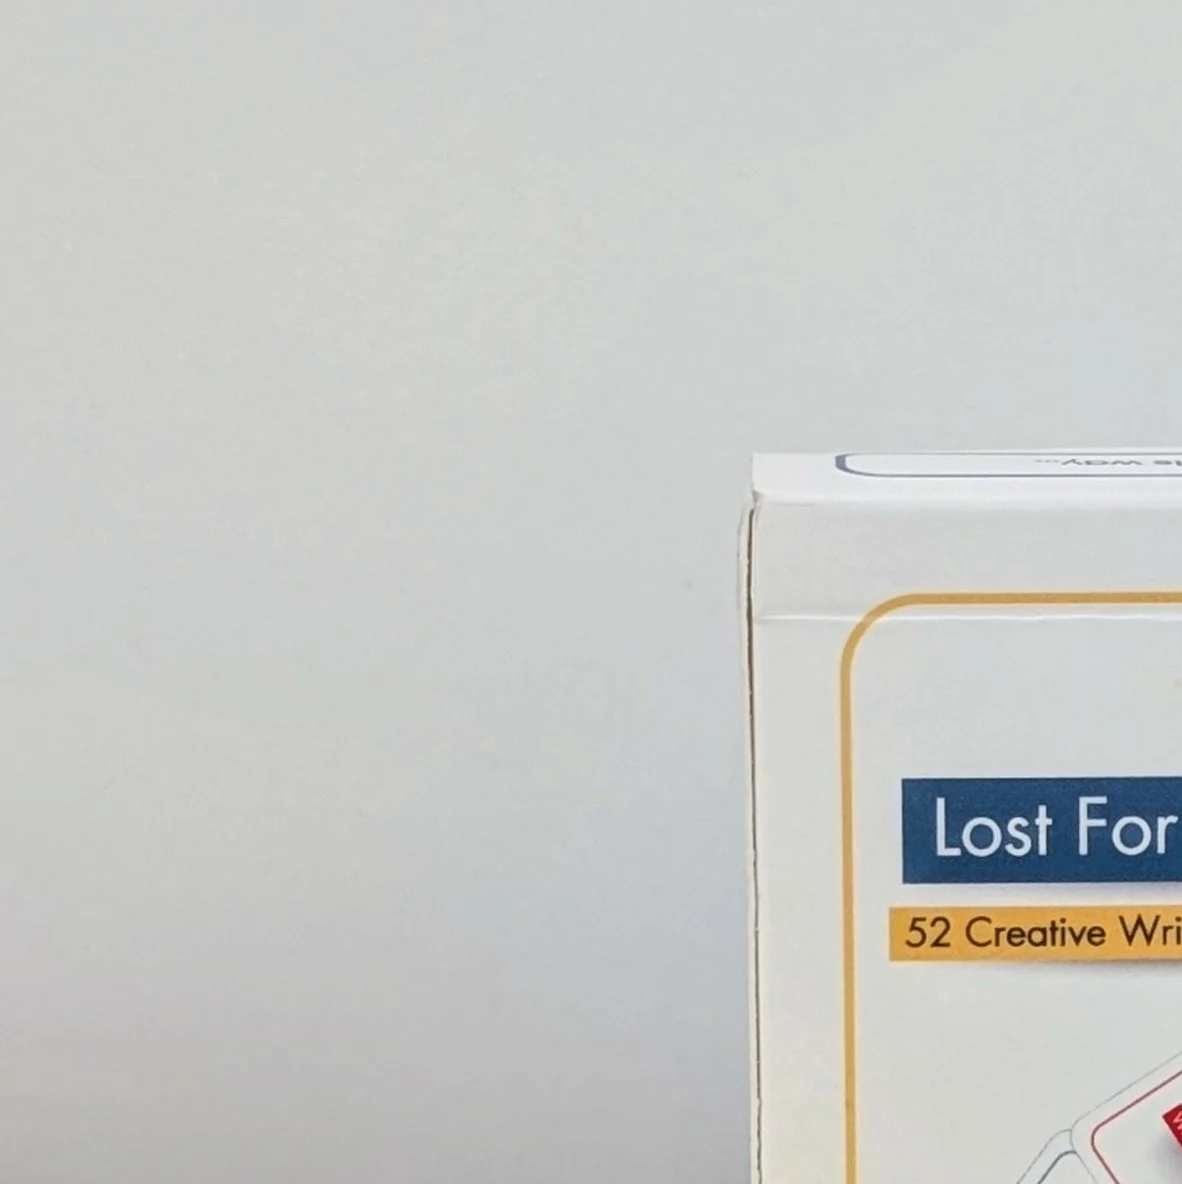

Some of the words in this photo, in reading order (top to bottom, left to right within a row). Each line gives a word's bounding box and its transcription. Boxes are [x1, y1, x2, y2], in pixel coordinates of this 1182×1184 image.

[935, 796, 1052, 858] Lost
[1078, 795, 1179, 856] For
[904, 916, 951, 949] 52
[965, 915, 1106, 948] Creative
